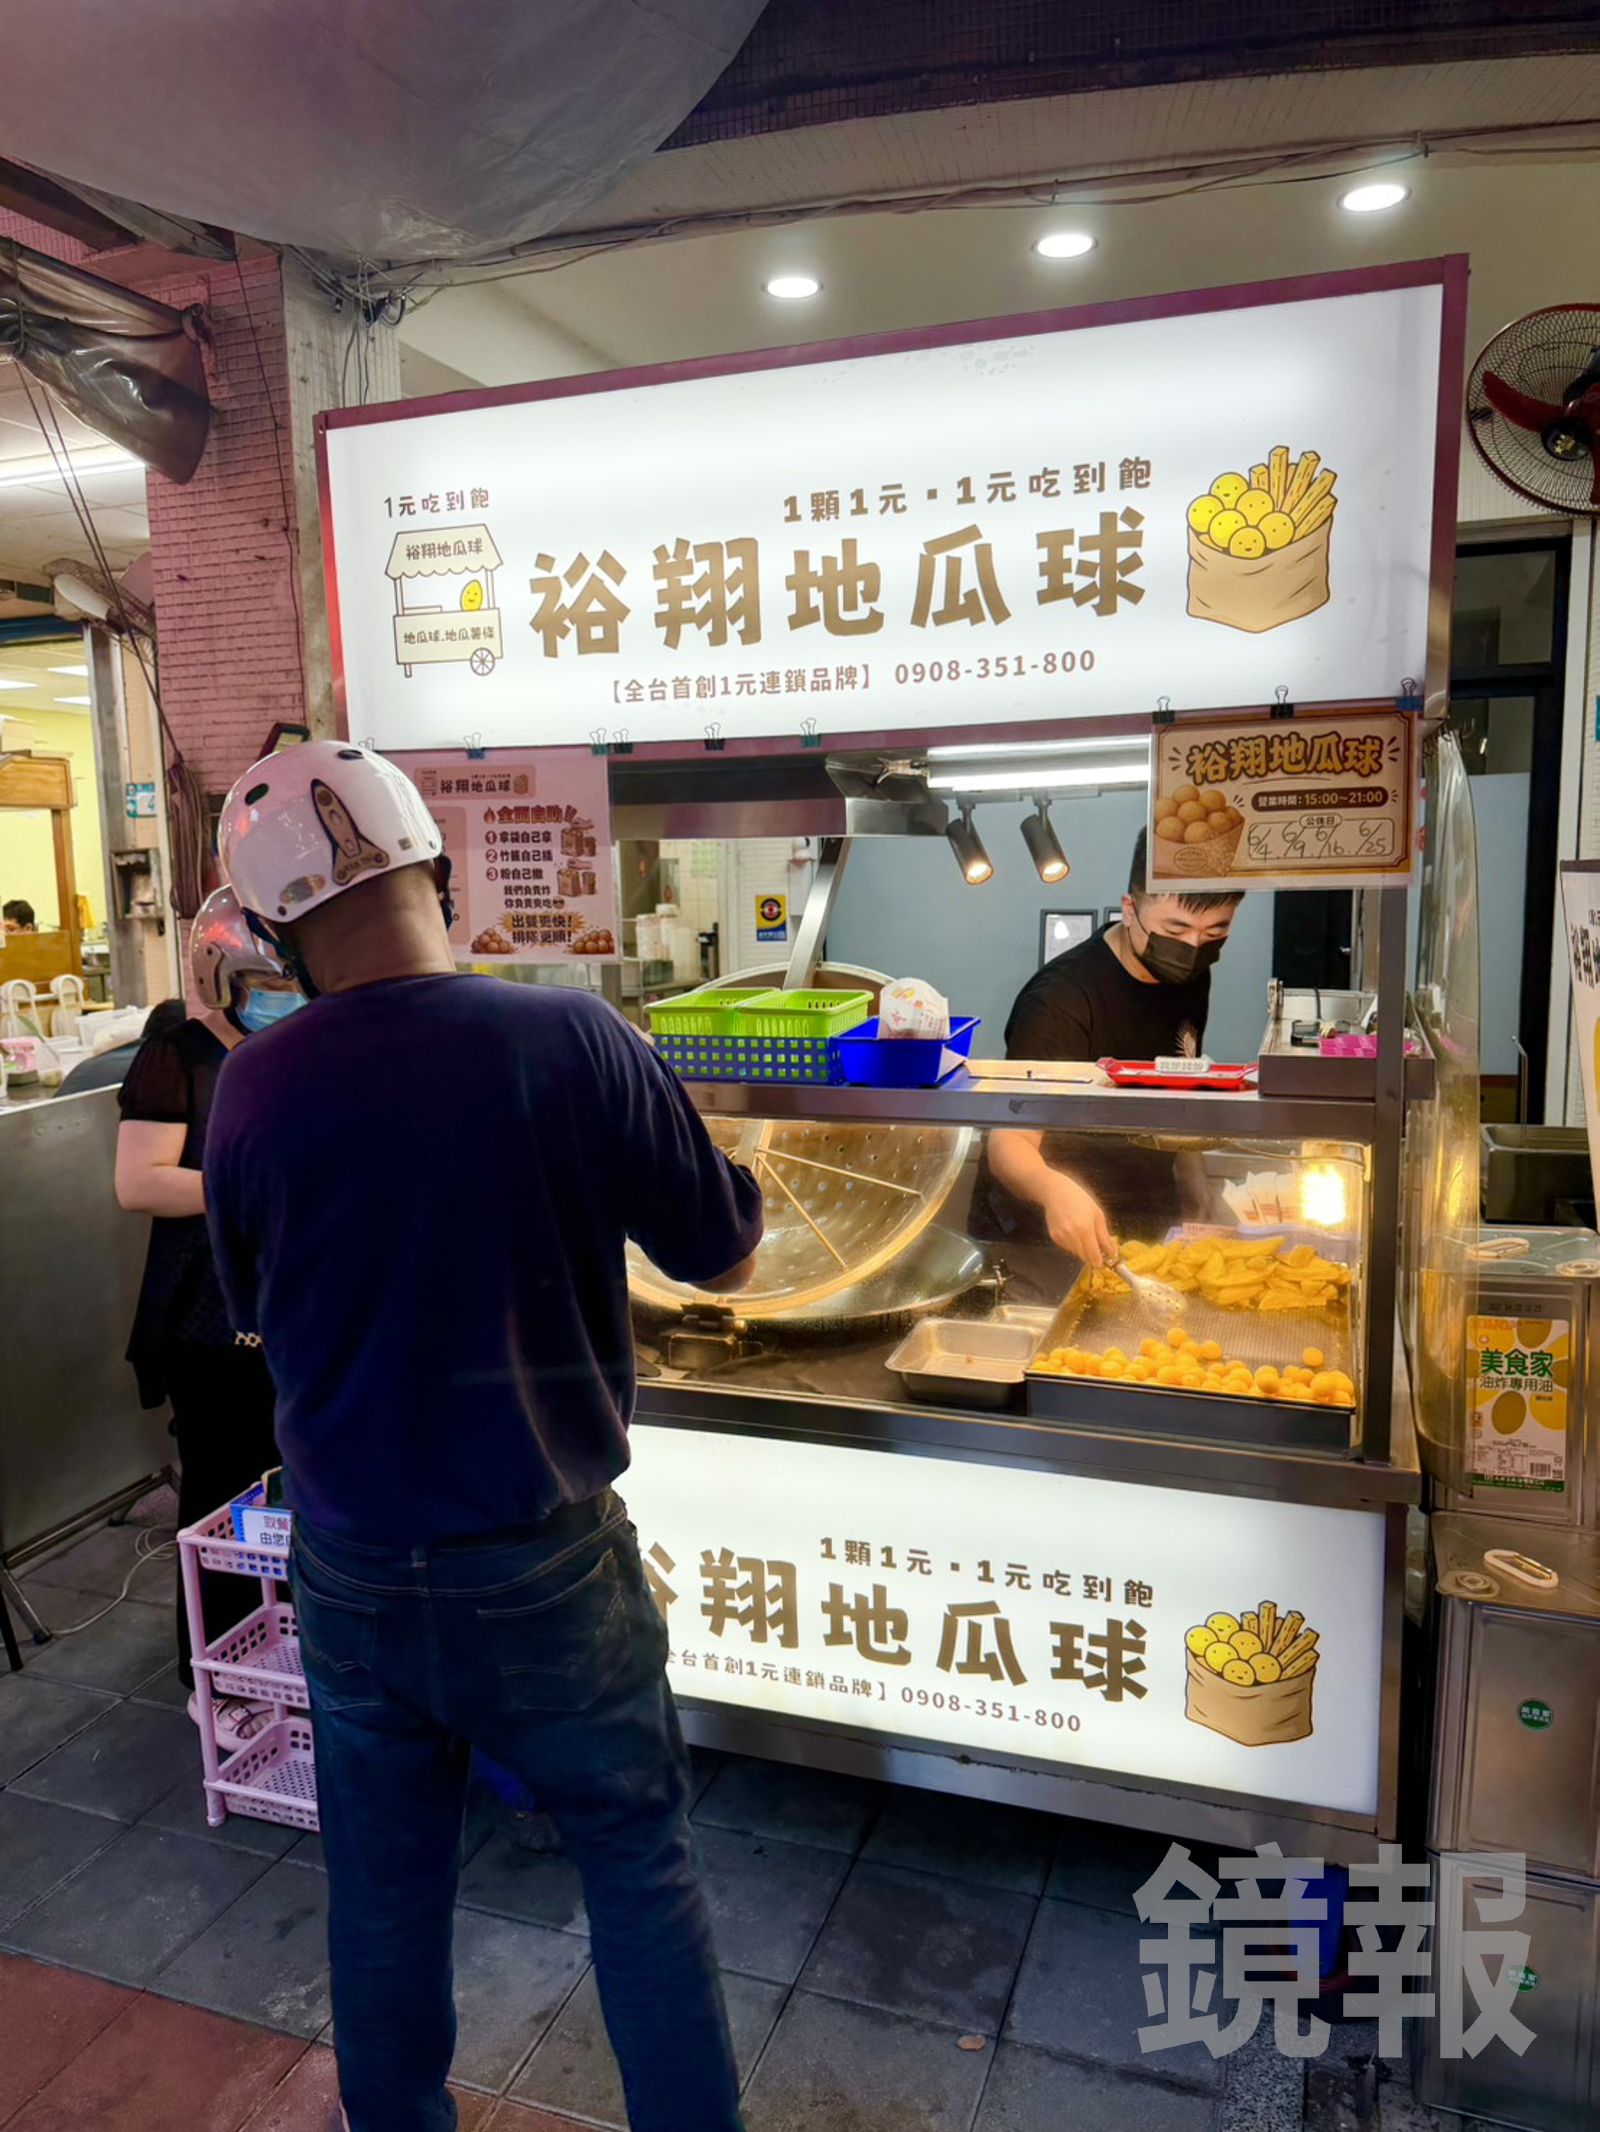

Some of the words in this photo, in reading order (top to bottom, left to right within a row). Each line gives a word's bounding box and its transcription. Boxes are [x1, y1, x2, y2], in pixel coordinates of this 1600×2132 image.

[384, 488, 490, 518] 1元吃到飽
[405, 538, 484, 561] 裕翔地瓜球
[529, 506, 1146, 658] 裕翔地瓜球
[613, 664, 870, 704] 【全台首創1元連鎖品牌】
[895, 650, 1096, 684] 0908-351-800
[1186, 731, 1384, 785] 裕翔地瓜球
[441, 779, 511, 793] 裕翔地瓜球
[1306, 816, 1335, 826] 公休日
[1480, 1347, 1553, 1378] 美食家
[1480, 1376, 1553, 1392] 油炸專用油
[901, 1687, 1081, 1732] 0908-351-800
